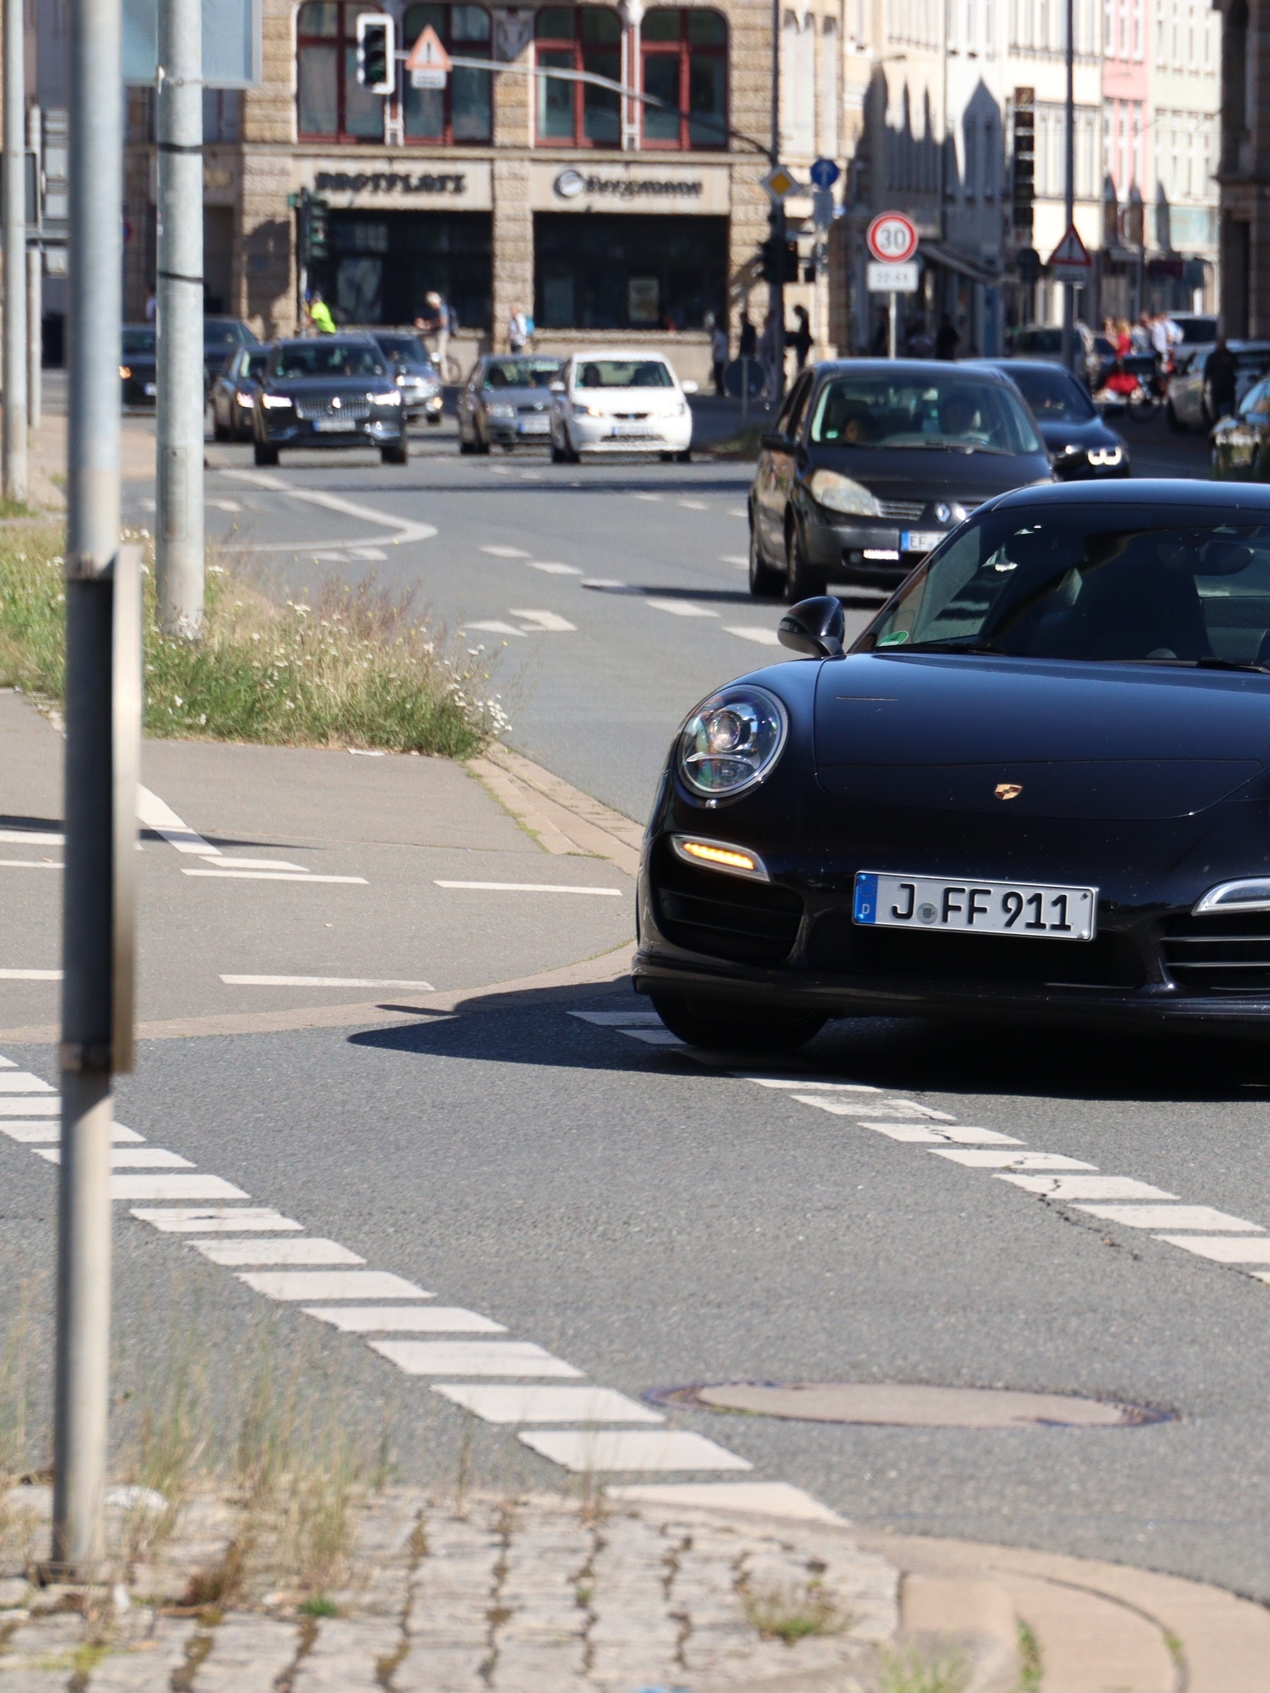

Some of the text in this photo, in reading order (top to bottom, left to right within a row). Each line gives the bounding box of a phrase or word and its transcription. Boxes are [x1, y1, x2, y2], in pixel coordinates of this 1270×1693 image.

[880, 227, 907, 250] 30
[891, 883, 1072, 932] J FF 911
